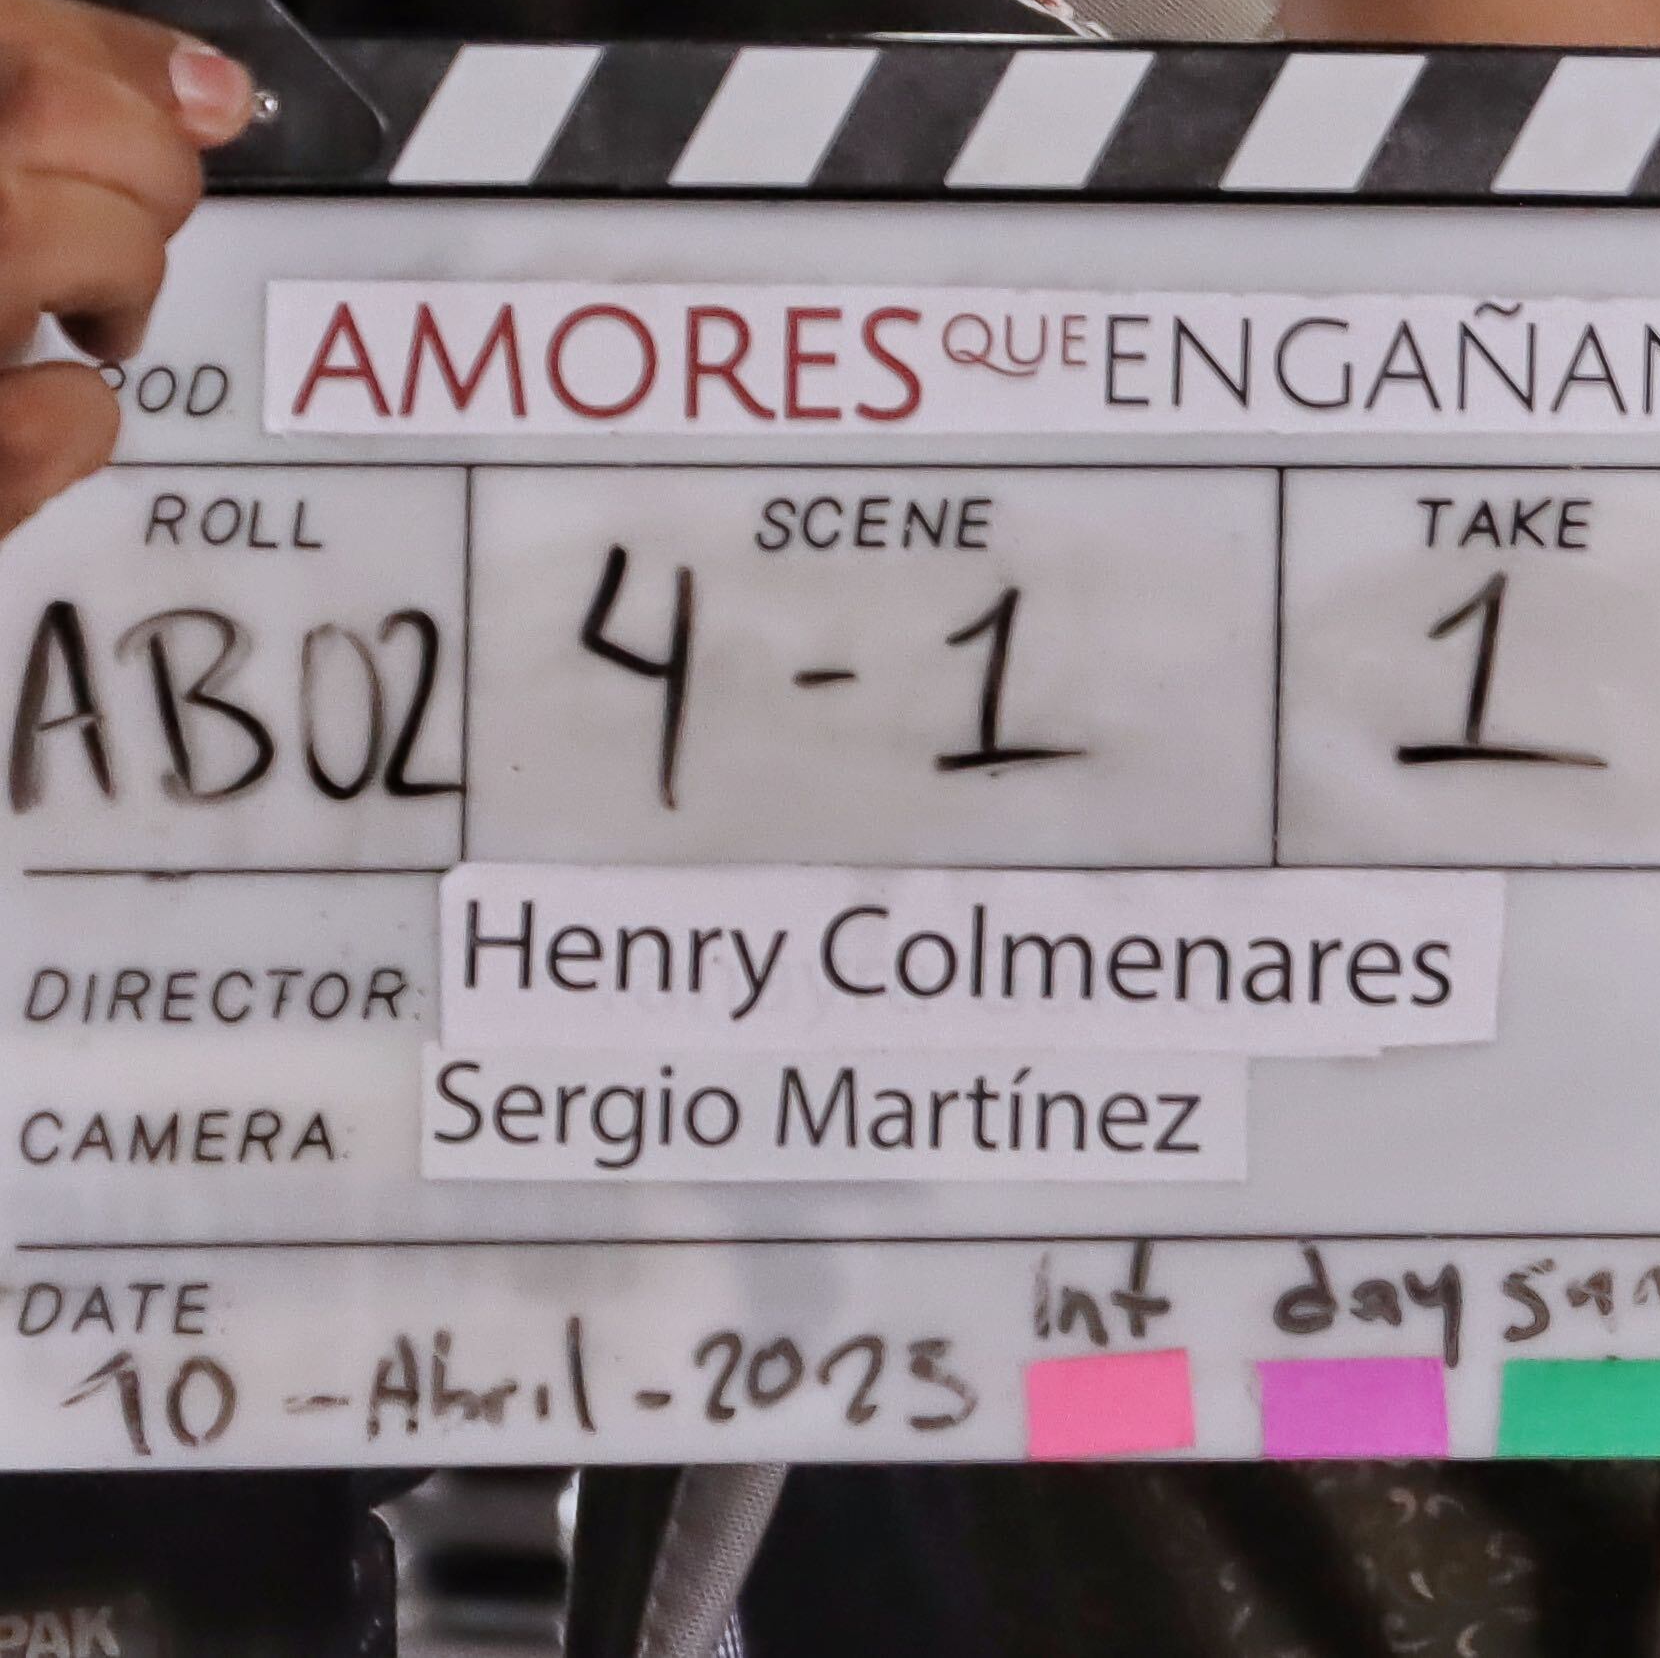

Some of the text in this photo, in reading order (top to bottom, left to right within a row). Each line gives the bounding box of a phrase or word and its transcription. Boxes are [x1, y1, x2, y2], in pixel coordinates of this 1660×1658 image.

[291, 300, 921, 421] AMORES
[942, 312, 1088, 379] QUE
[145, 494, 323, 548] ROLL
[755, 497, 994, 552] SCENE
[1417, 497, 1594, 550] TAKE
[1395, 571, 1608, 769] 1
[463, 900, 1453, 1021] Henry Colmenares
[433, 1060, 1203, 1168] Sergio Martínez
[17, 1282, 211, 1335] DATE
[1273, 1242, 1462, 1369] day
